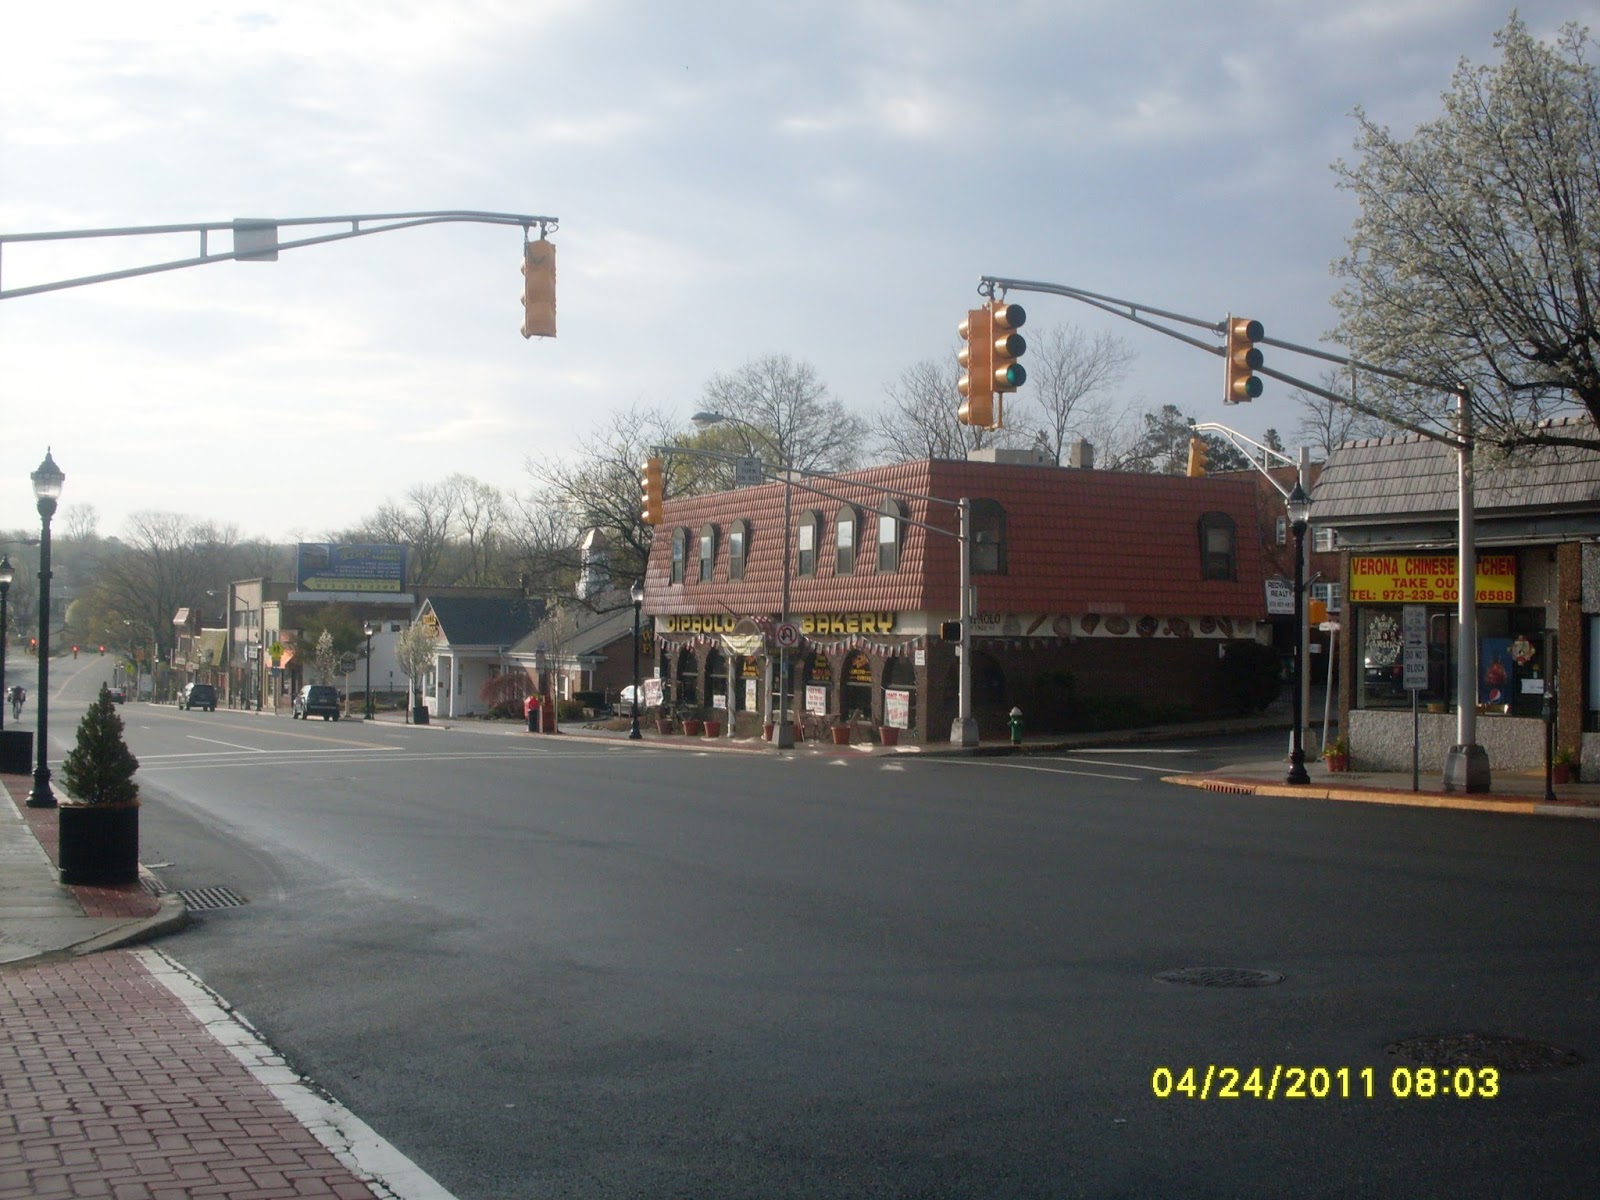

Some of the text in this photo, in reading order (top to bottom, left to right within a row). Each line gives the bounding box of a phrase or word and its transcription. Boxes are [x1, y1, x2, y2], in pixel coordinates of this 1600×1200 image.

[1352, 558, 1515, 576] VERONA CHINESE TCHEN
[1392, 578, 1428, 588] TAKE
[1351, 590, 1376, 600] TEL:
[667, 613, 894, 634] DIPAOLO BAKERY
[1406, 650, 1426, 659] DO NOT
[1406, 663, 1425, 672] BLOCK
